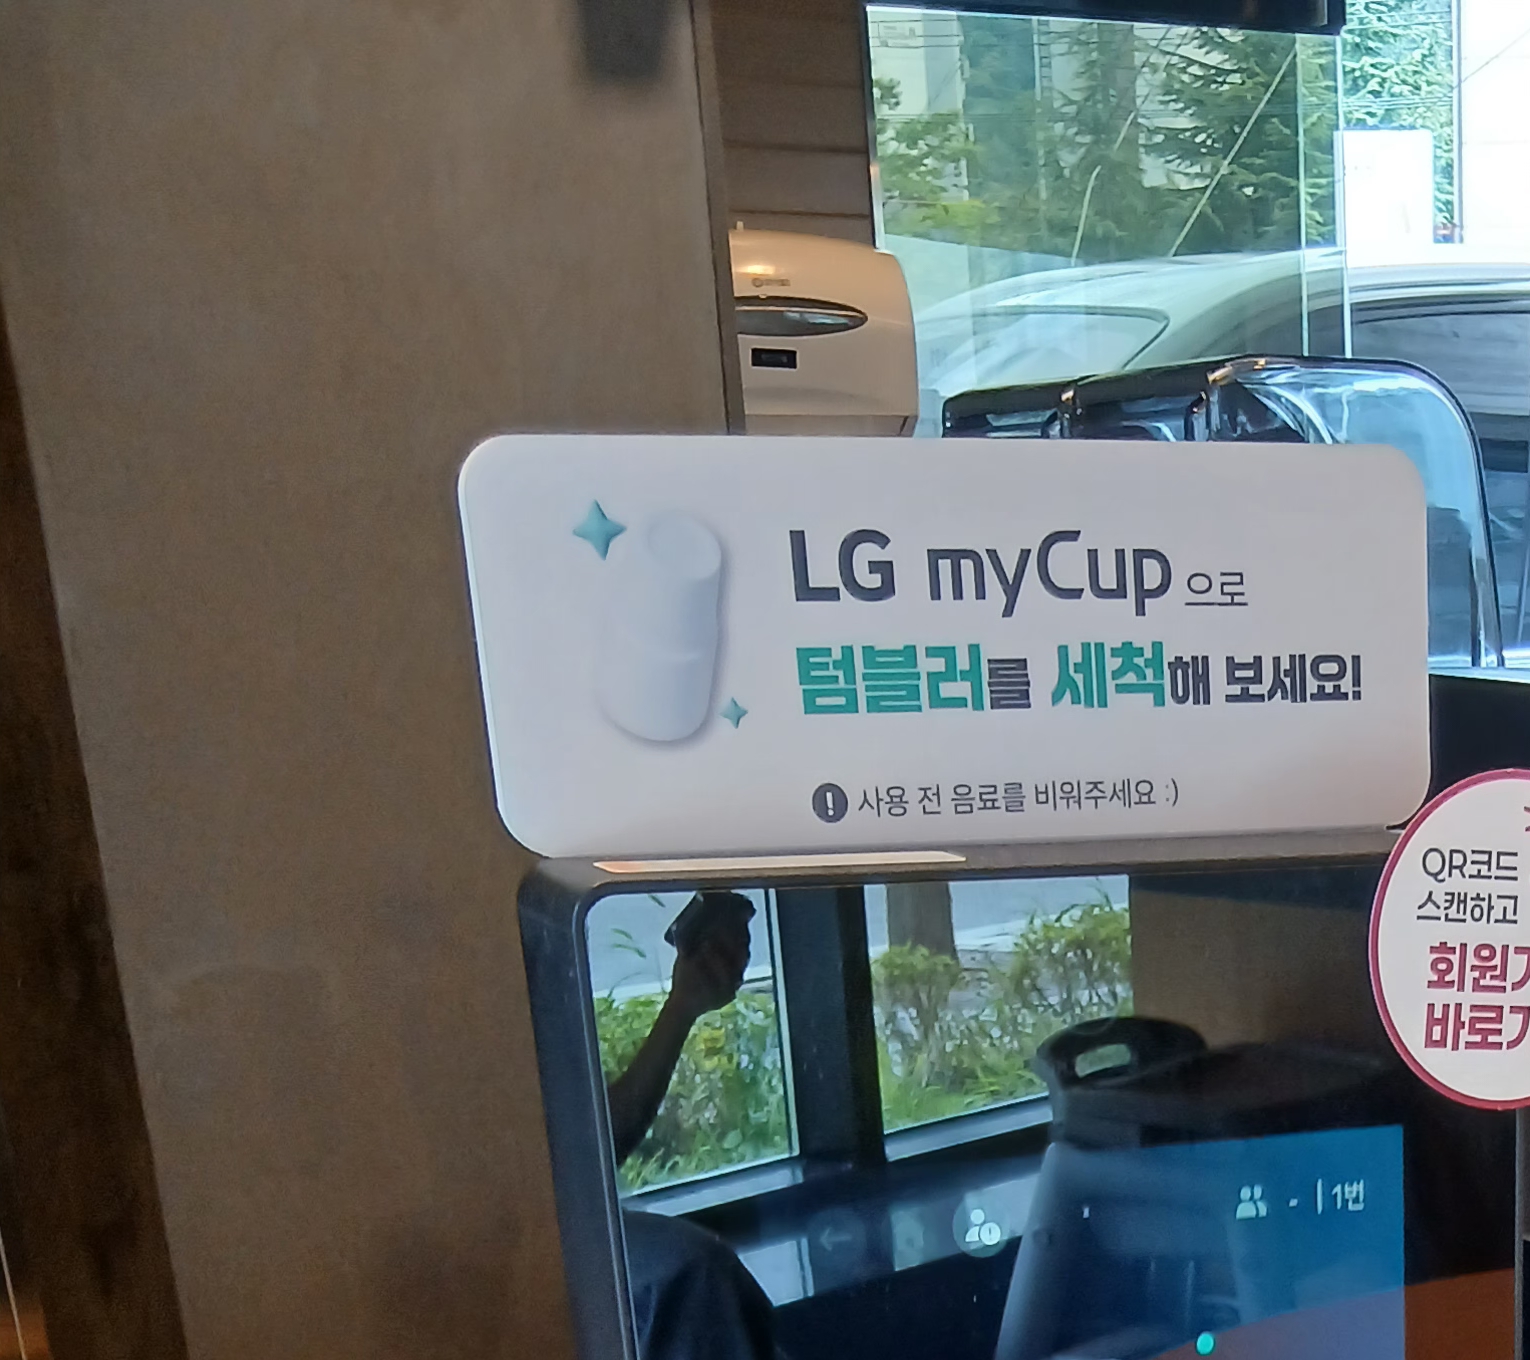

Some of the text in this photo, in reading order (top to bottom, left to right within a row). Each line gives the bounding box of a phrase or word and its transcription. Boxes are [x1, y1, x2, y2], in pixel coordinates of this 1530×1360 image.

[789, 529, 896, 604] LG
[796, 641, 1363, 714] 텀블러를 세척해 보세요!
[857, 787, 910, 818] 사용
[918, 784, 943, 815] 전
[951, 782, 1027, 814] 음료를
[1034, 780, 1155, 813] 비워주세요
[1422, 847, 1519, 883] QR코드
[1416, 890, 1519, 925] 스캔하고
